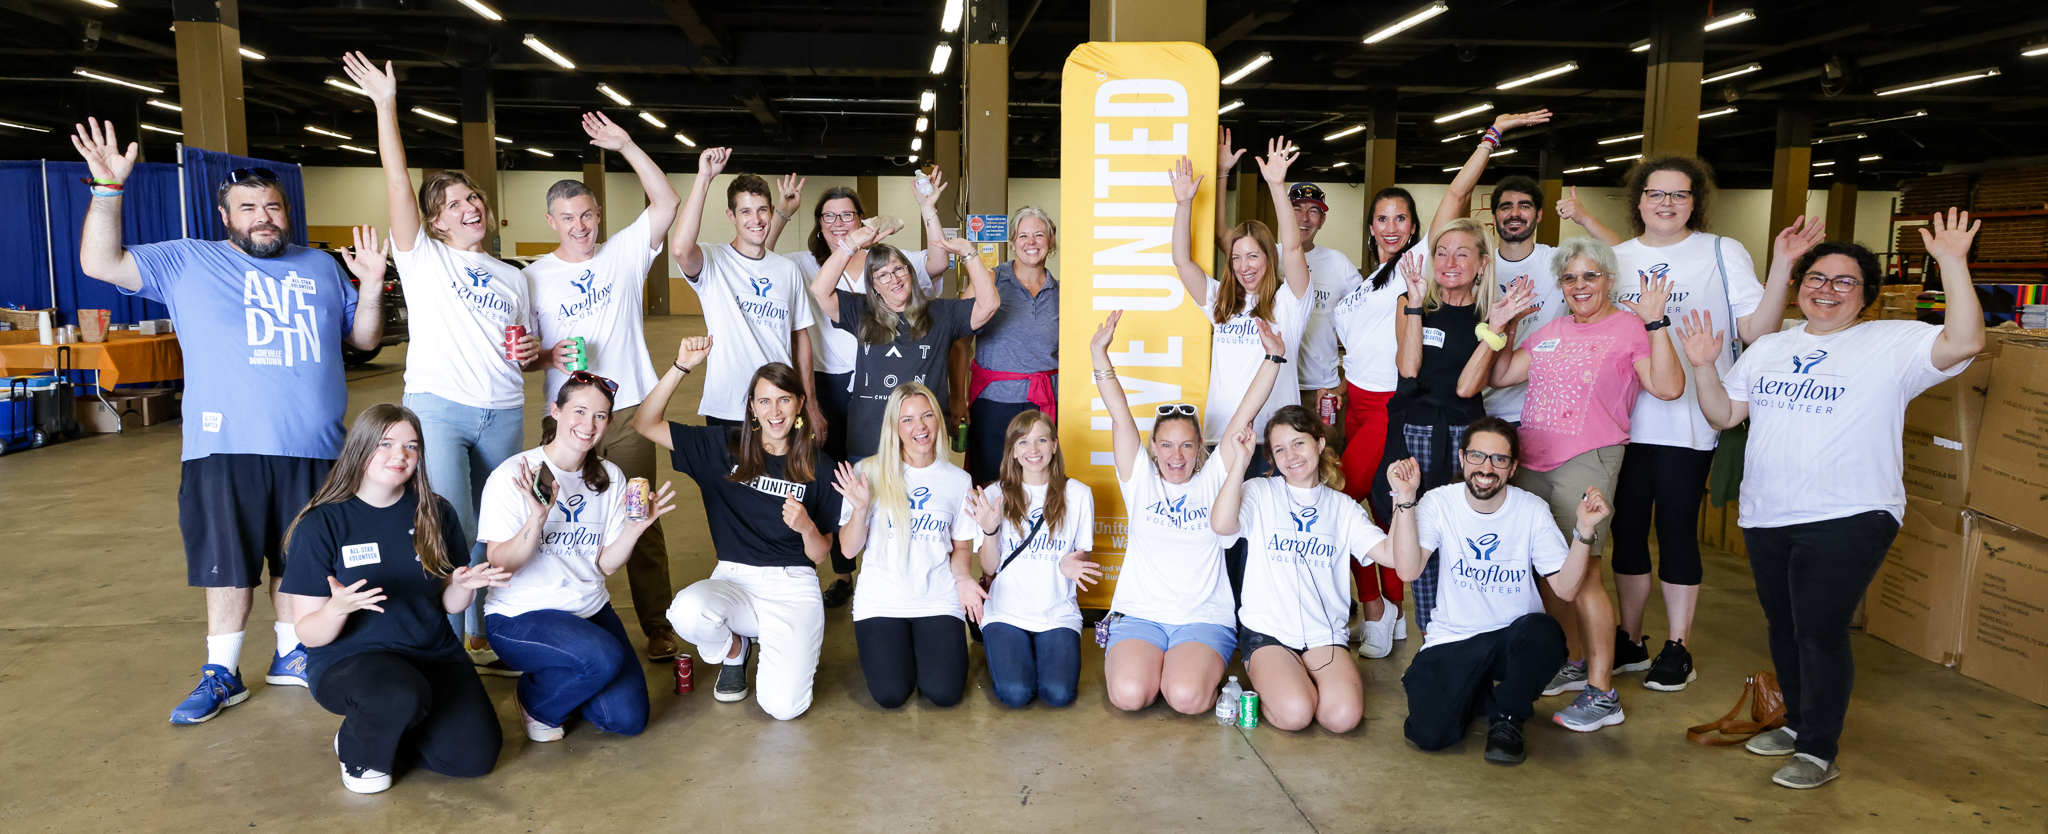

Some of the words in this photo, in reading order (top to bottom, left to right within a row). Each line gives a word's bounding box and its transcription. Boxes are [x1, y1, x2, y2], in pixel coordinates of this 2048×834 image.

[1092, 78, 1189, 312] UNITED
[1216, 319, 1259, 339] Aeroflo
[1216, 337, 1261, 345] VOLUNTEE
[249, 357, 282, 366] DOWNTOWN
[253, 349, 282, 358] ASHEVILLE
[1750, 376, 1846, 402] Aeroflow
[1090, 335, 1184, 466] IVE
[761, 478, 804, 499] UNITED
[1094, 522, 1129, 535] Unite
[350, 546, 374, 555] ALL-STAR
[1111, 536, 1129, 549] Wa
[1267, 533, 1337, 557] Aeroflow
[349, 552, 378, 562] VOLUNTEER
[1244, 698, 1254, 724] Sprite
